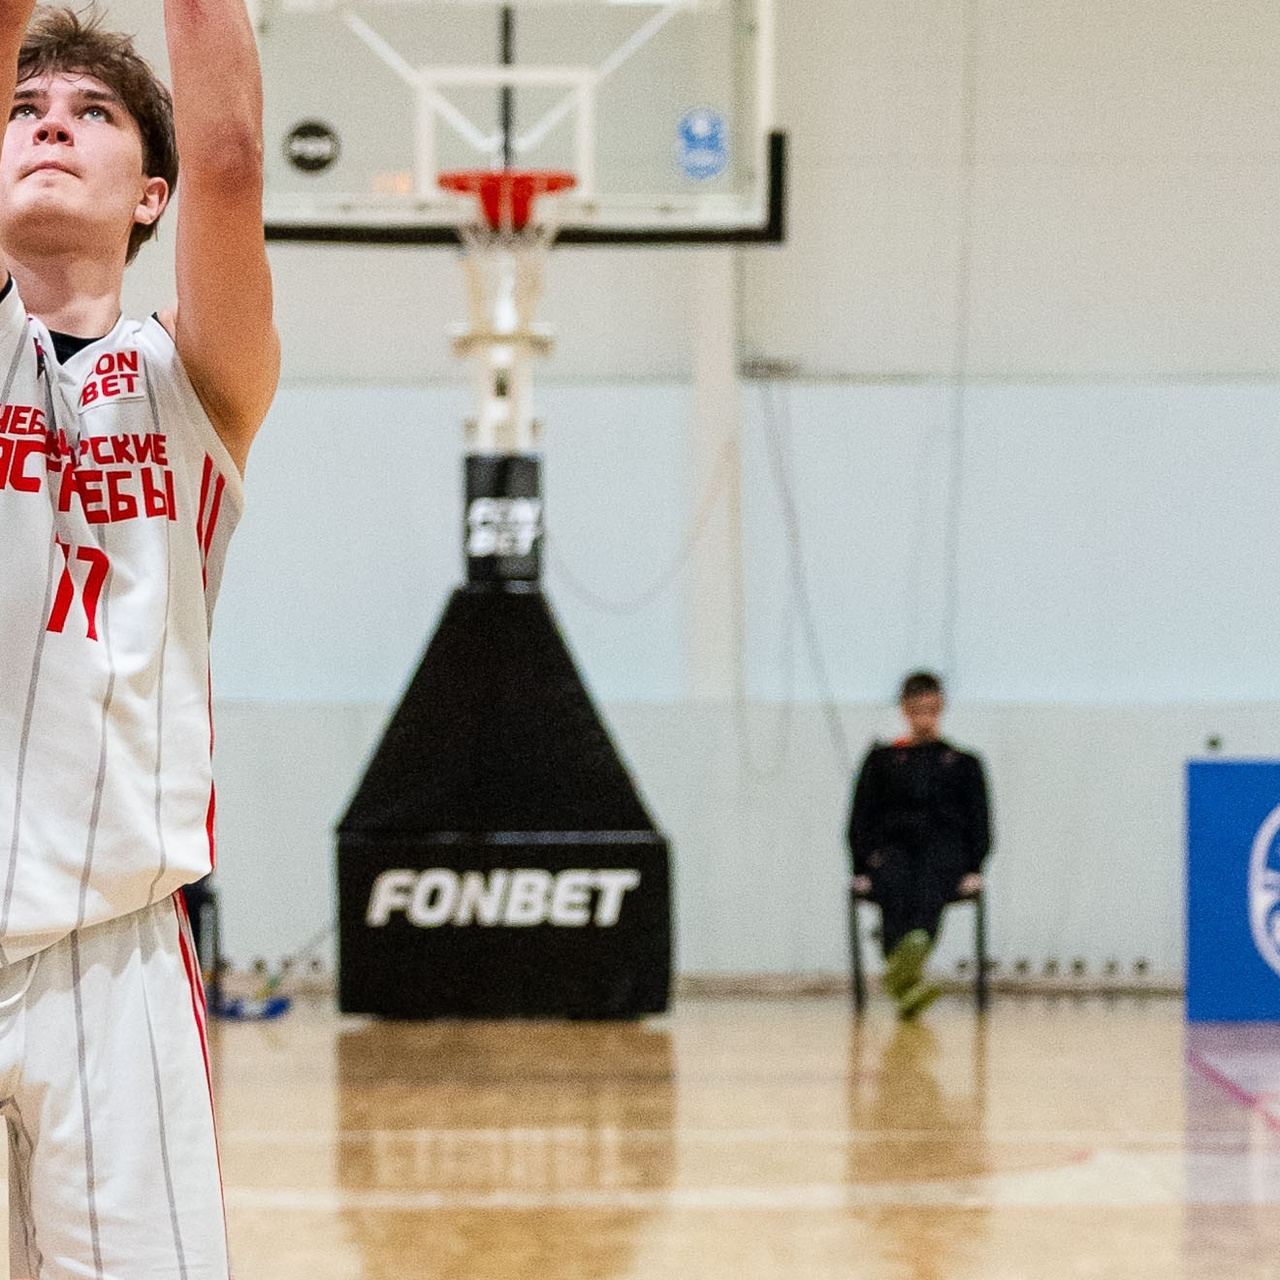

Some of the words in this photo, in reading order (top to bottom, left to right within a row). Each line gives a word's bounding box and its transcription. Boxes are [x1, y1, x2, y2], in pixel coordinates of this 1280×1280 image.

[88, 350, 139, 377] ON
[81, 373, 140, 407] BET
[45, 532, 111, 642] 17
[367, 867, 642, 927] FONBET
